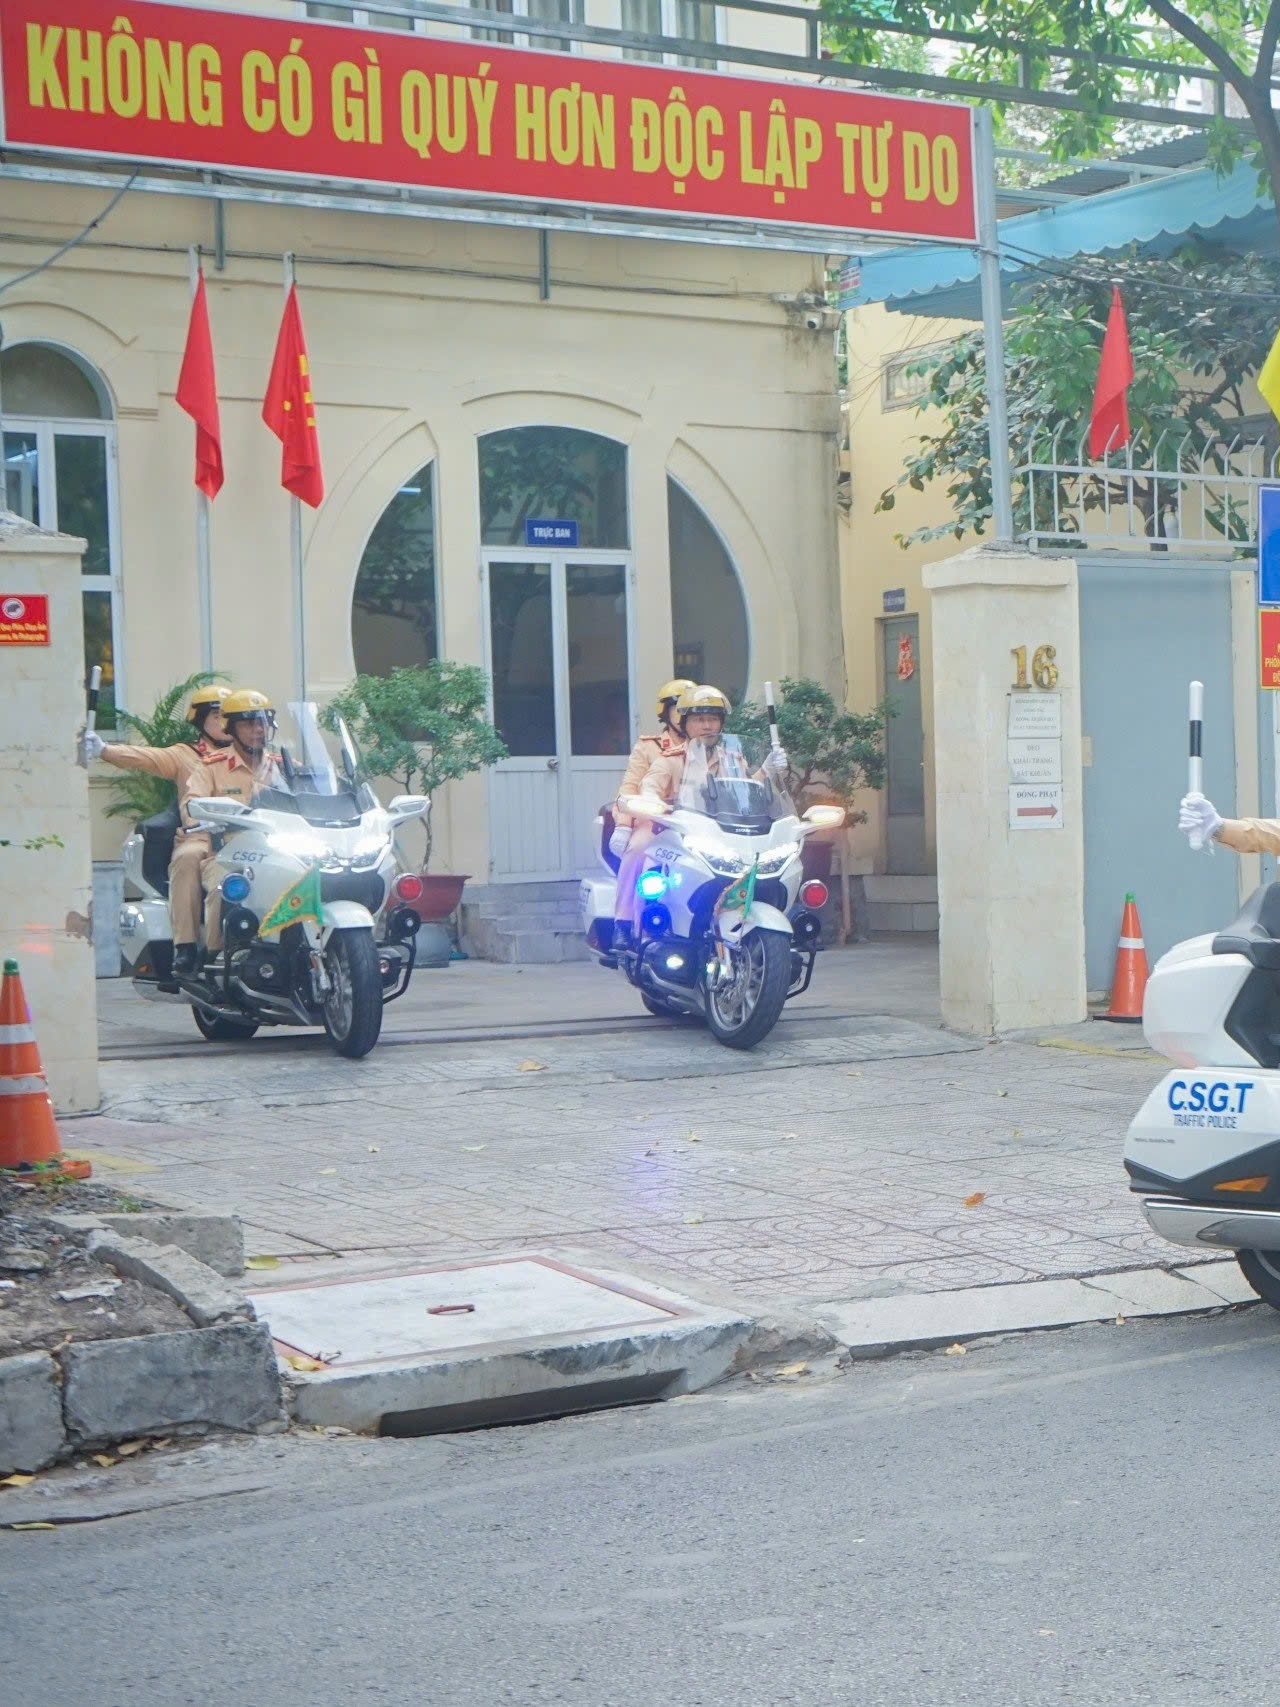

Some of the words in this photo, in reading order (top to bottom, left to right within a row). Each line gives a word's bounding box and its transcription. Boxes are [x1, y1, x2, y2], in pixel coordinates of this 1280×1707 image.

[26, 16, 224, 127] KHÔNG
[241, 39, 313, 137] CÓ
[331, 48, 383, 145] GÌ
[401, 62, 499, 159] QUÝ
[514, 81, 616, 170] HƠN
[630, 86, 725, 195] ĐỘC
[739, 98, 823, 204] LẬP
[835, 120, 893, 214] TỰ
[902, 130, 960, 206] DO
[554, 527, 571, 538] BAN
[1010, 644, 1059, 689] 16
[232, 850, 268, 863] CSGT
[655, 847, 683, 863] CSGT
[1168, 1080, 1254, 1113] C.S.G.T
[1173, 1114, 1205, 1127] TRAFFIC
[1207, 1115, 1238, 1129] POLICE
